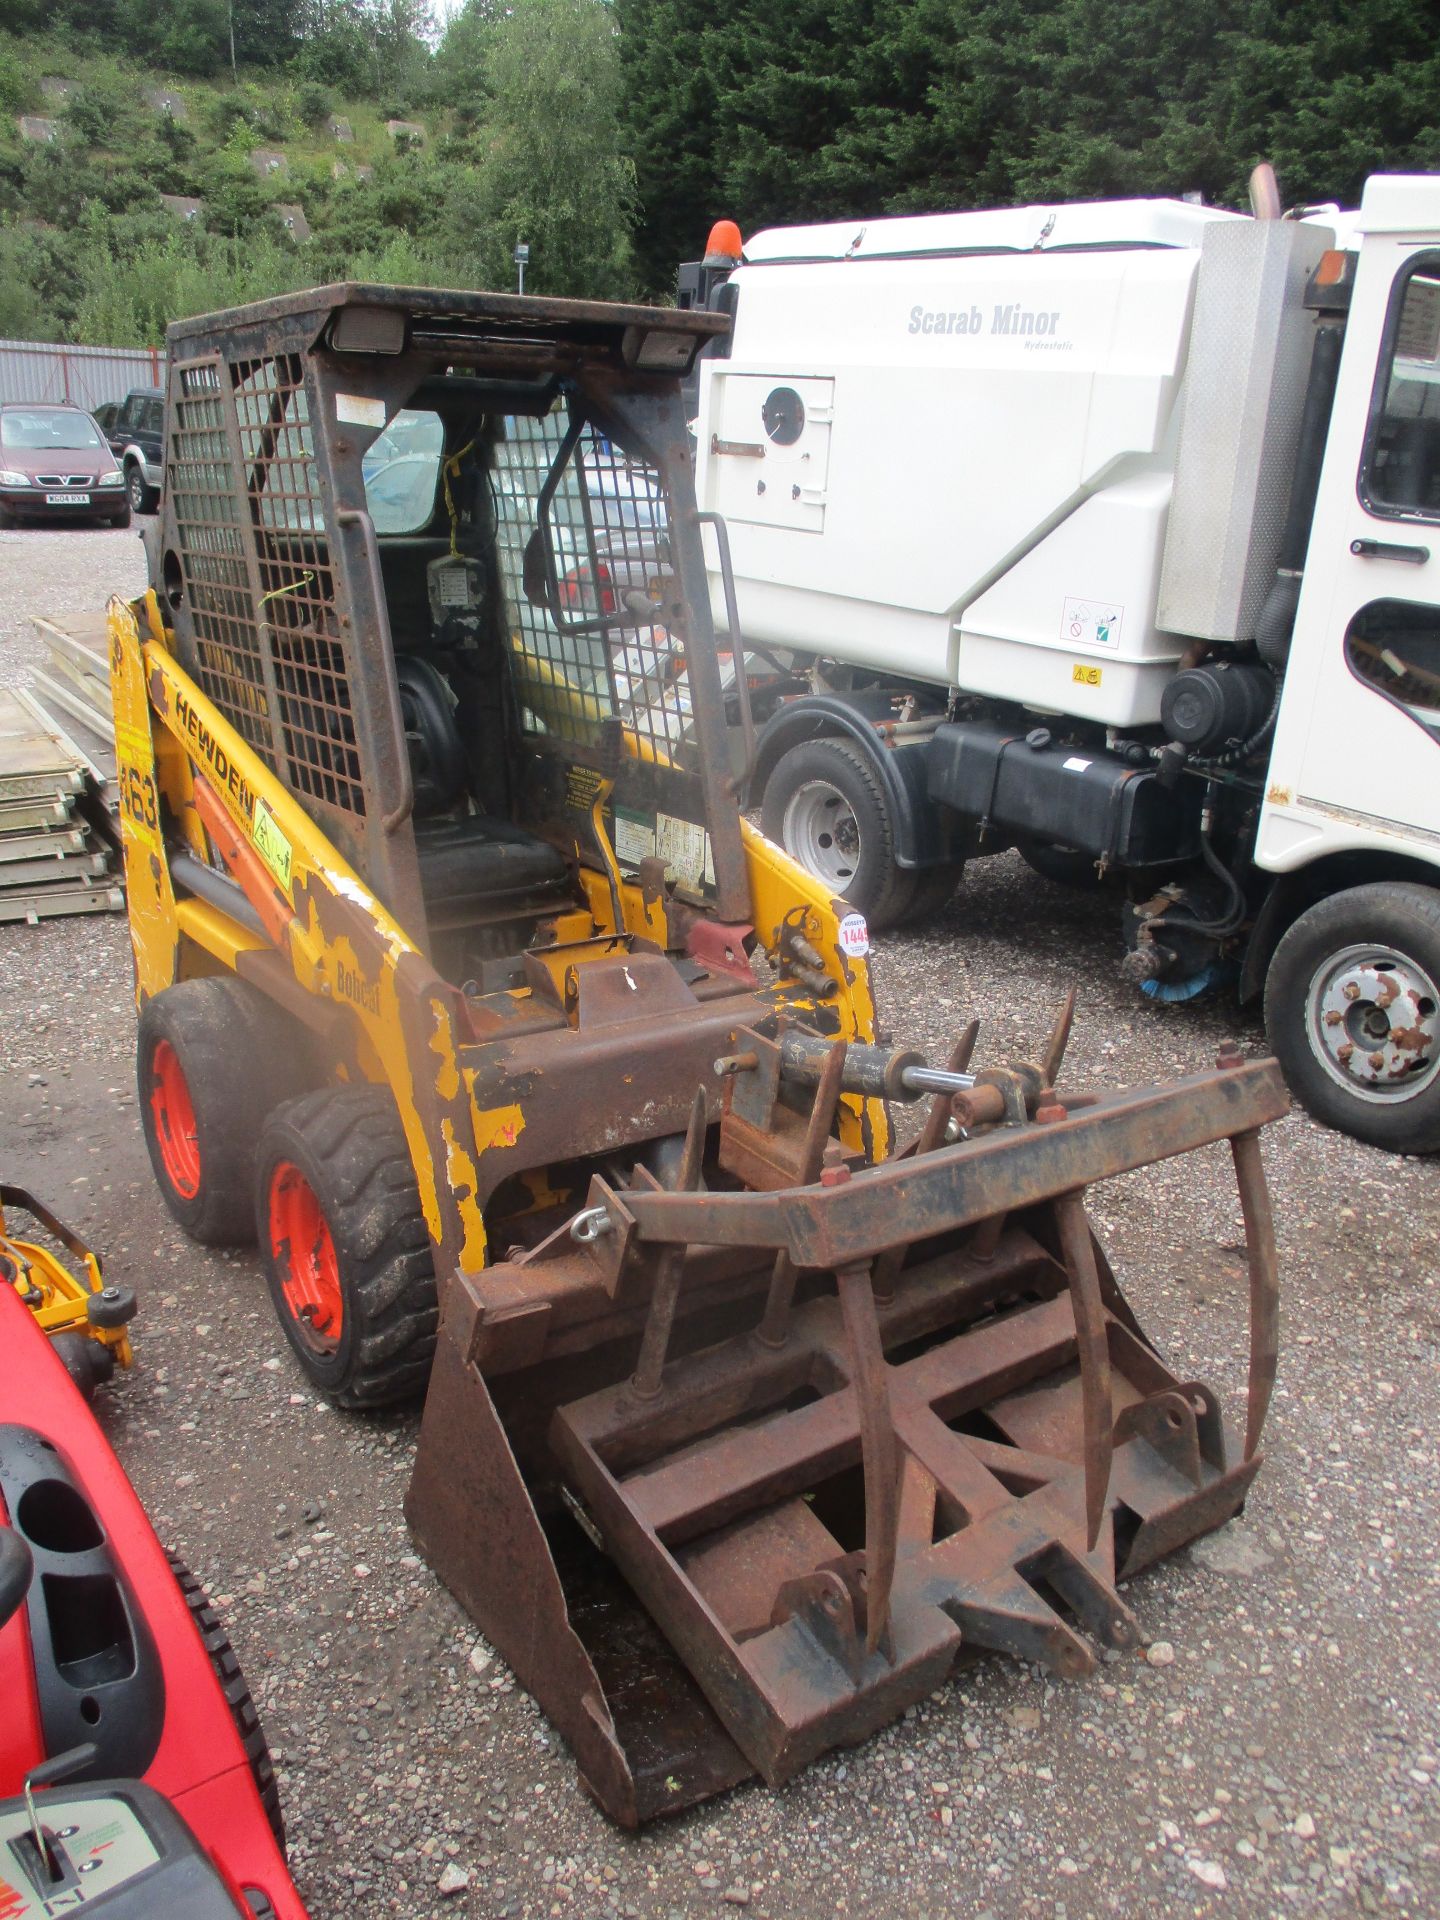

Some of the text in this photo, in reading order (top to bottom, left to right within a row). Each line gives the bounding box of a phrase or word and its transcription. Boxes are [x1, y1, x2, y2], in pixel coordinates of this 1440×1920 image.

[908, 303, 1060, 336] Scarab Minor
[1024, 340, 1074, 351] Hydrostatic
[175, 691, 254, 820] HEWDEN
